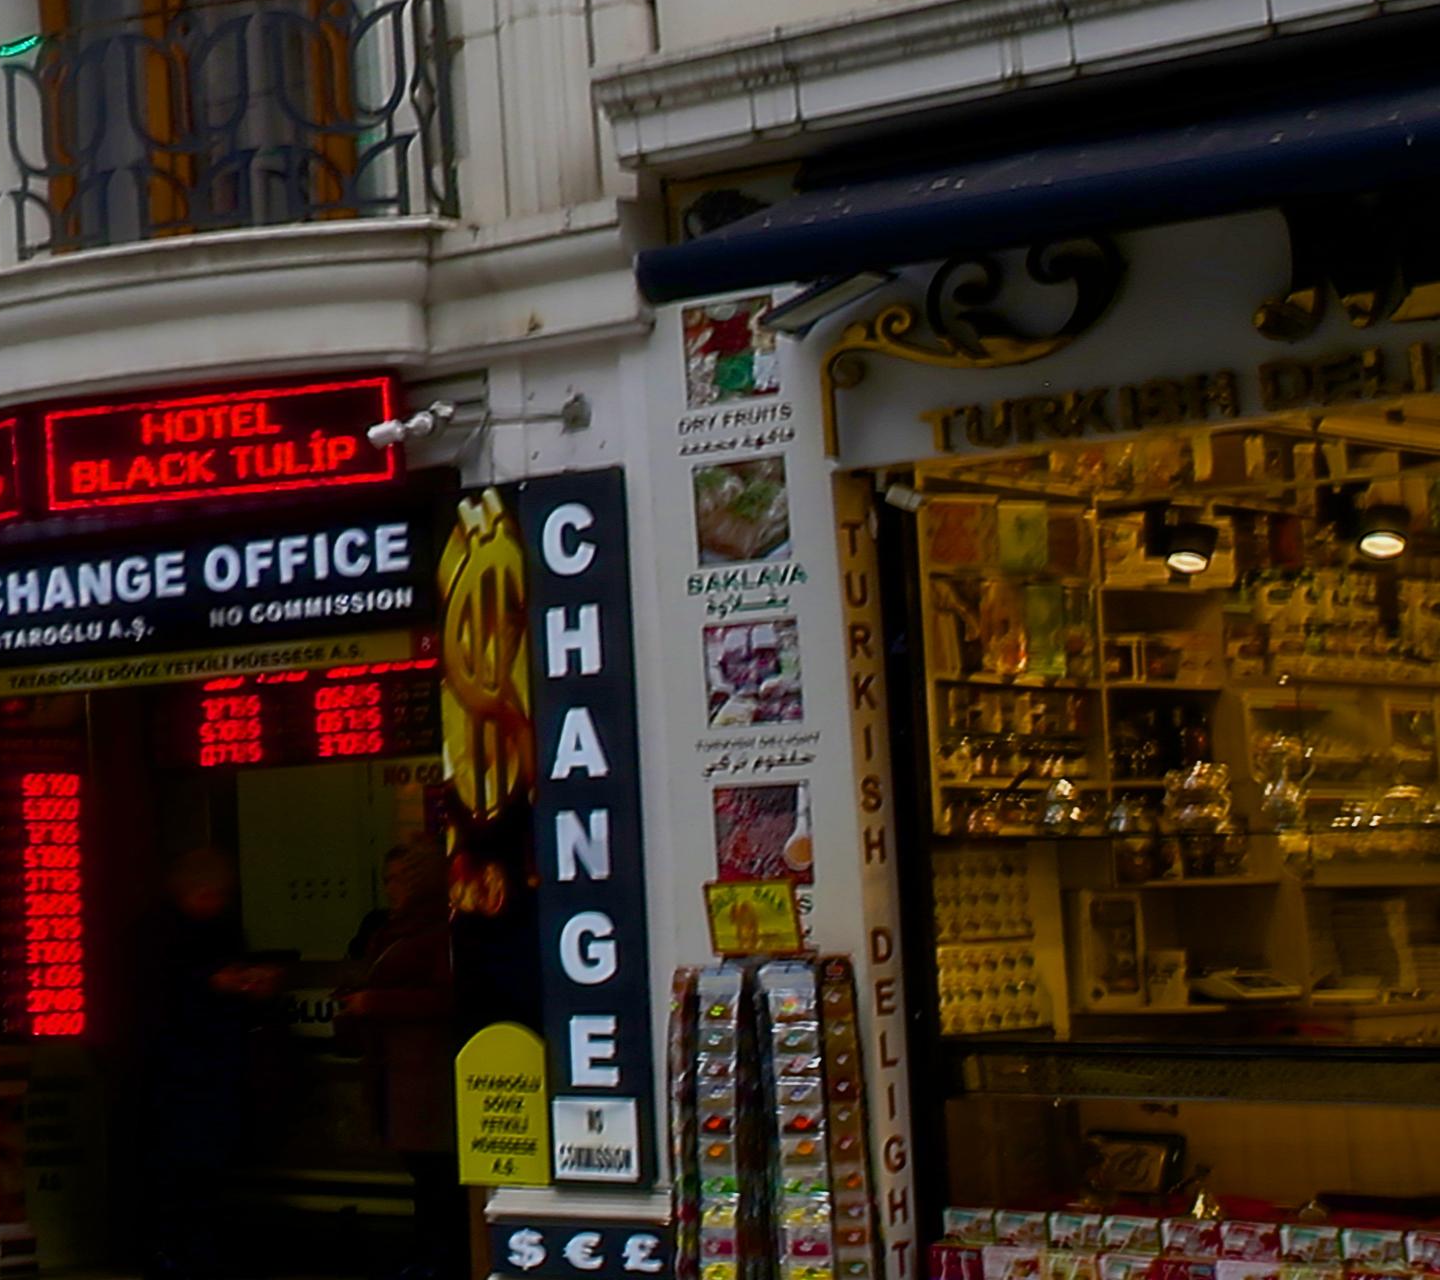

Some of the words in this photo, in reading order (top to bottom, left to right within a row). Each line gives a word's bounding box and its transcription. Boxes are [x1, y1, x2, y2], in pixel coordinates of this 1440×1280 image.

[141, 401, 282, 446] HOTEL
[920, 369, 1240, 453] TURKISH
[1257, 340, 1440, 410] DELI
[70, 448, 216, 494] BLACK
[230, 429, 357, 481] TULİP
[203, 522, 411, 592] OFFICE
[687, 564, 808, 596] BAKLAVA
[209, 603, 241, 628] NO
[249, 586, 413, 624] COMMISSION
[541, 501, 619, 1087] CHANGE
[842, 521, 886, 866] TURKISH
[870, 926, 911, 1279] DELIGHT
